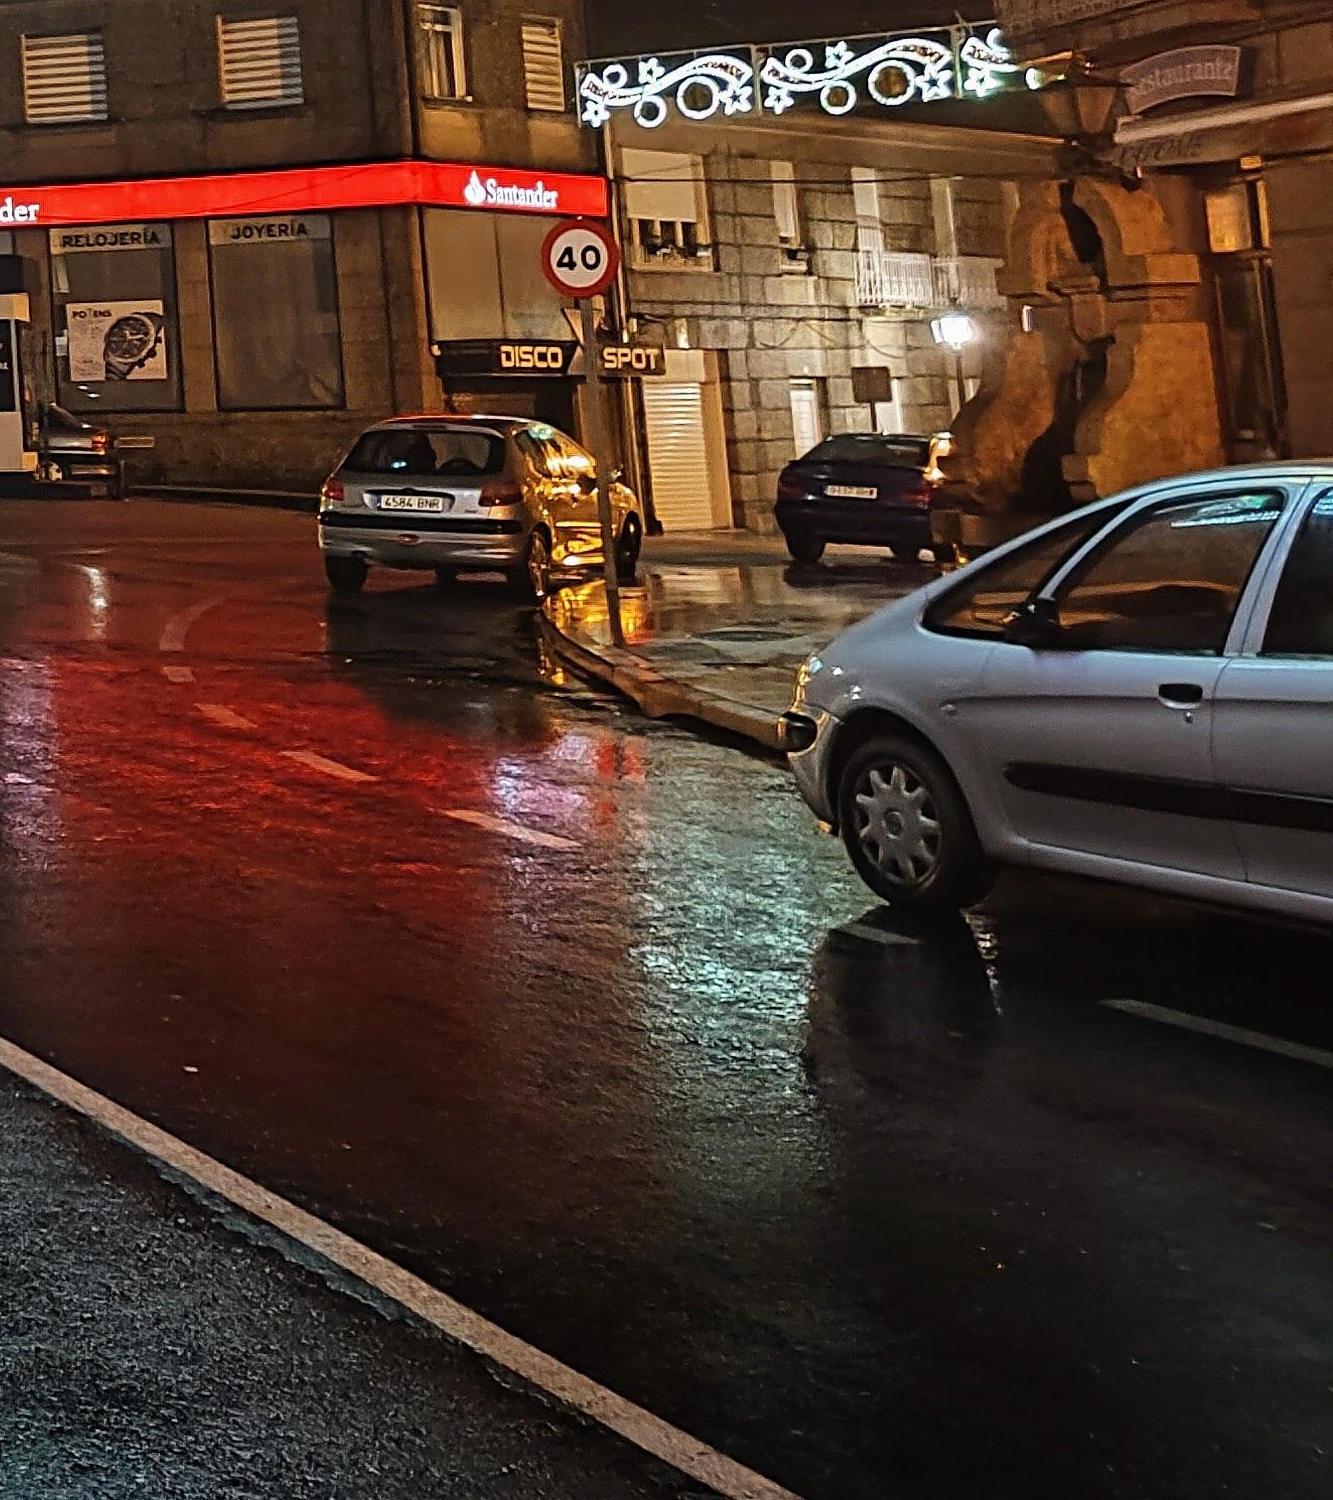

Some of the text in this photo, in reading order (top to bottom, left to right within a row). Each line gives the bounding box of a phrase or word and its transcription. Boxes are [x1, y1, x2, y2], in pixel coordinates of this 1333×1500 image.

[486, 177, 558, 208] Santander
[61, 227, 161, 248] RELOJERÍA
[230, 221, 309, 240] JOYERÍA
[556, 245, 601, 270] 40
[500, 345, 659, 369] DISCO SPOT
